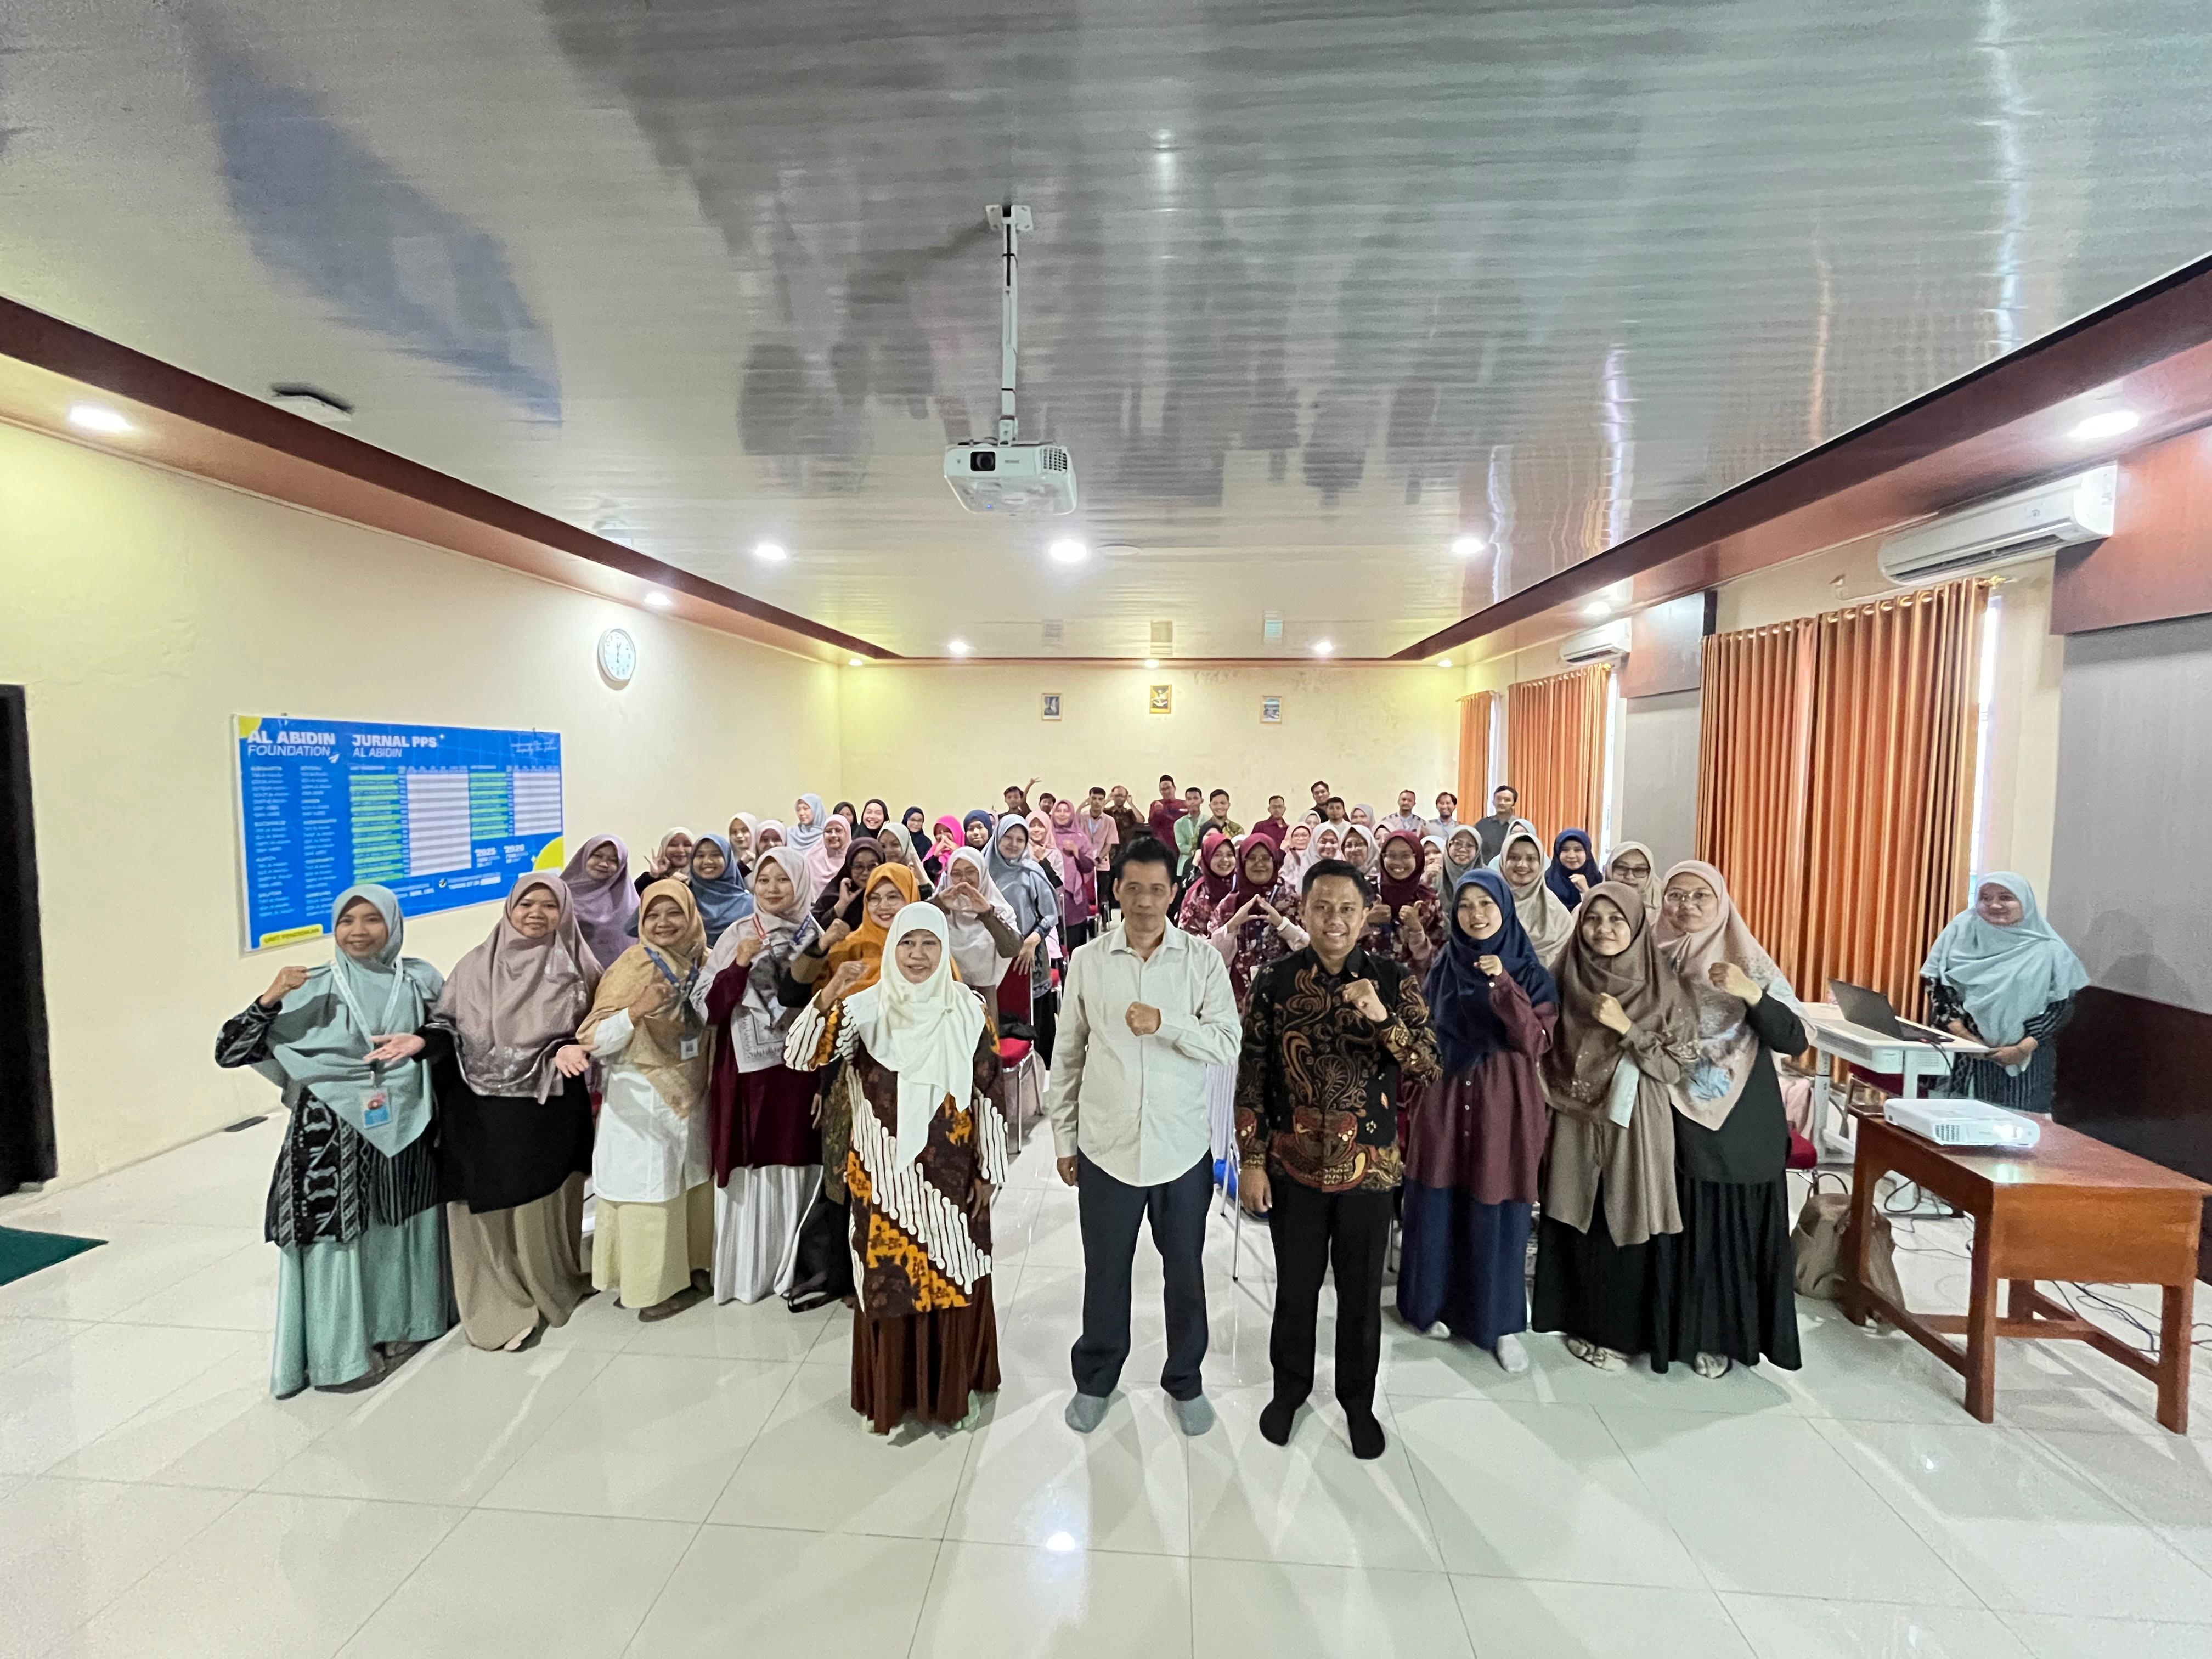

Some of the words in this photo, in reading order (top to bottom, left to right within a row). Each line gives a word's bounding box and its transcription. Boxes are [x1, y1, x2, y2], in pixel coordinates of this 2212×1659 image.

[248, 731, 273, 744] AL
[276, 731, 336, 745] ABIDIN
[352, 734, 410, 747] JURNAL
[412, 736, 437, 748] PPS
[249, 746, 331, 757] FOUNDATION
[353, 748, 367, 757] AL
[369, 747, 402, 758] ABIDIN
